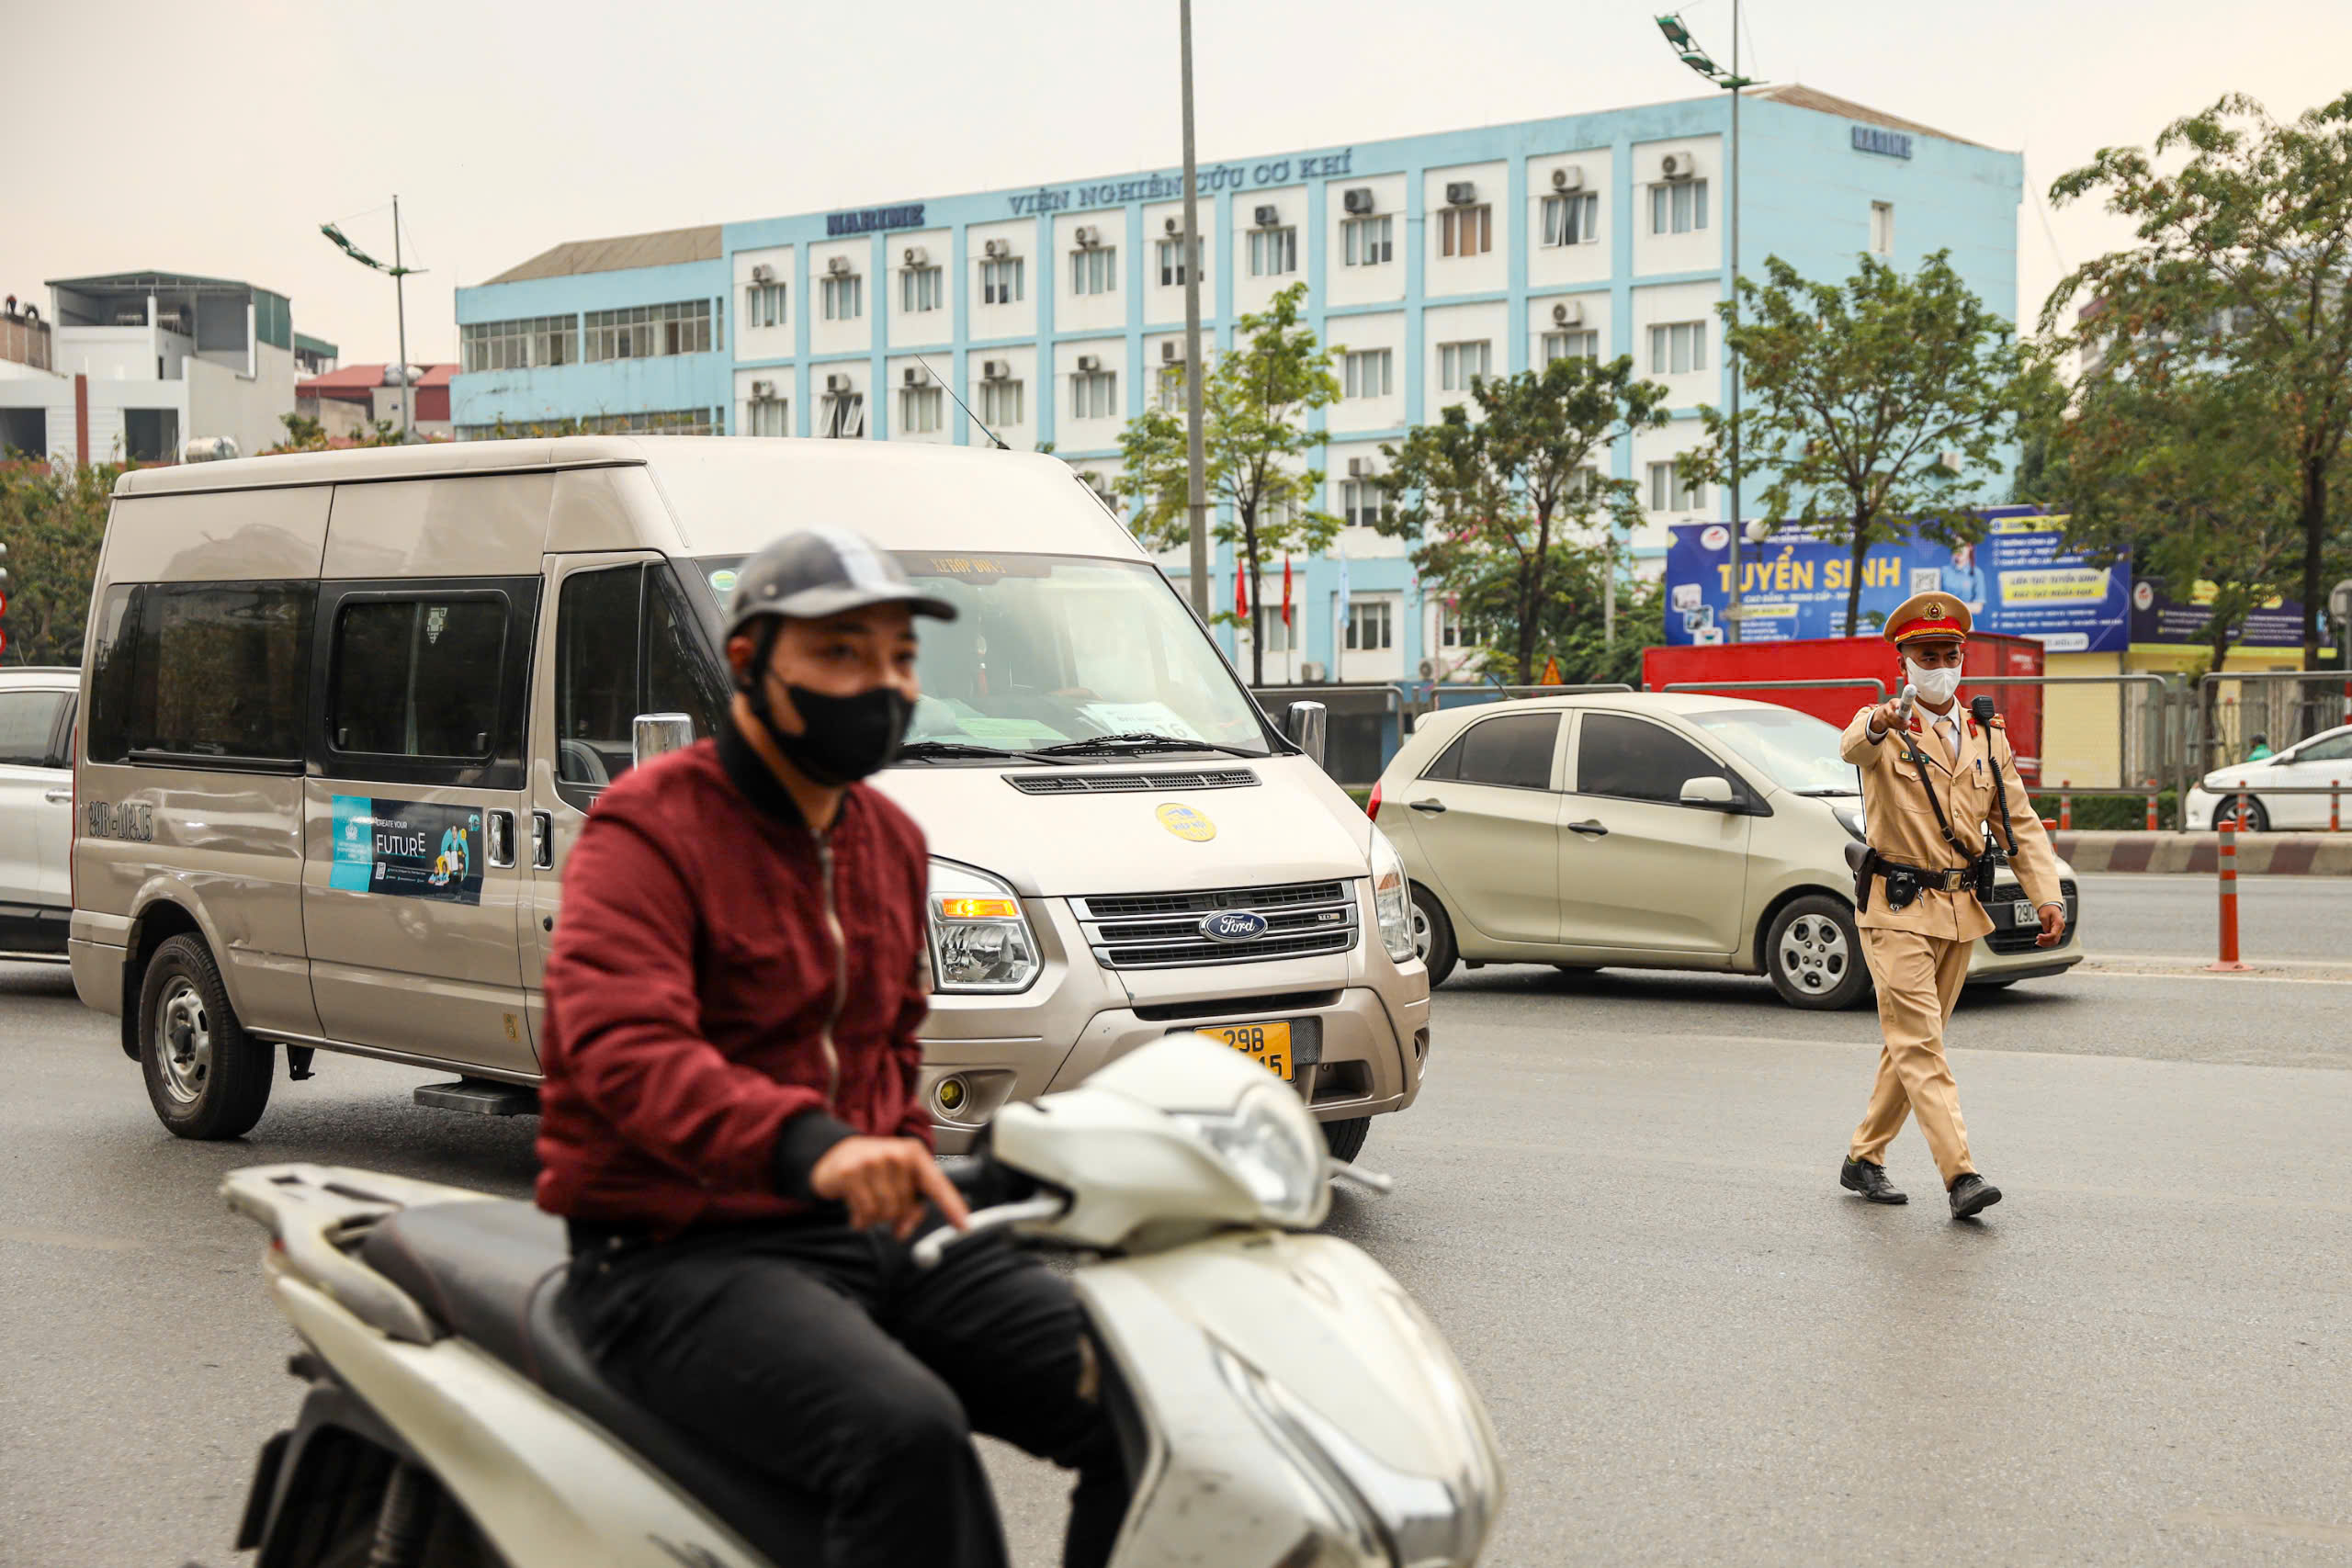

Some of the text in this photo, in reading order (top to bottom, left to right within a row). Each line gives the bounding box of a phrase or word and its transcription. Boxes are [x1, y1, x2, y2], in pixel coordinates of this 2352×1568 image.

[1008, 187, 1070, 216] VIỆN
[1079, 174, 1184, 208] NGHIÊN
[1253, 159, 1290, 186] CƠ
[1300, 148, 1353, 179] KHÍ
[1717, 545, 1901, 592] TUYỂN SINH
[393, 820, 408, 829] YOUR
[376, 832, 426, 857] FUTURE
[1219, 914, 1257, 934] Ford
[1223, 1027, 1264, 1053] 29B
